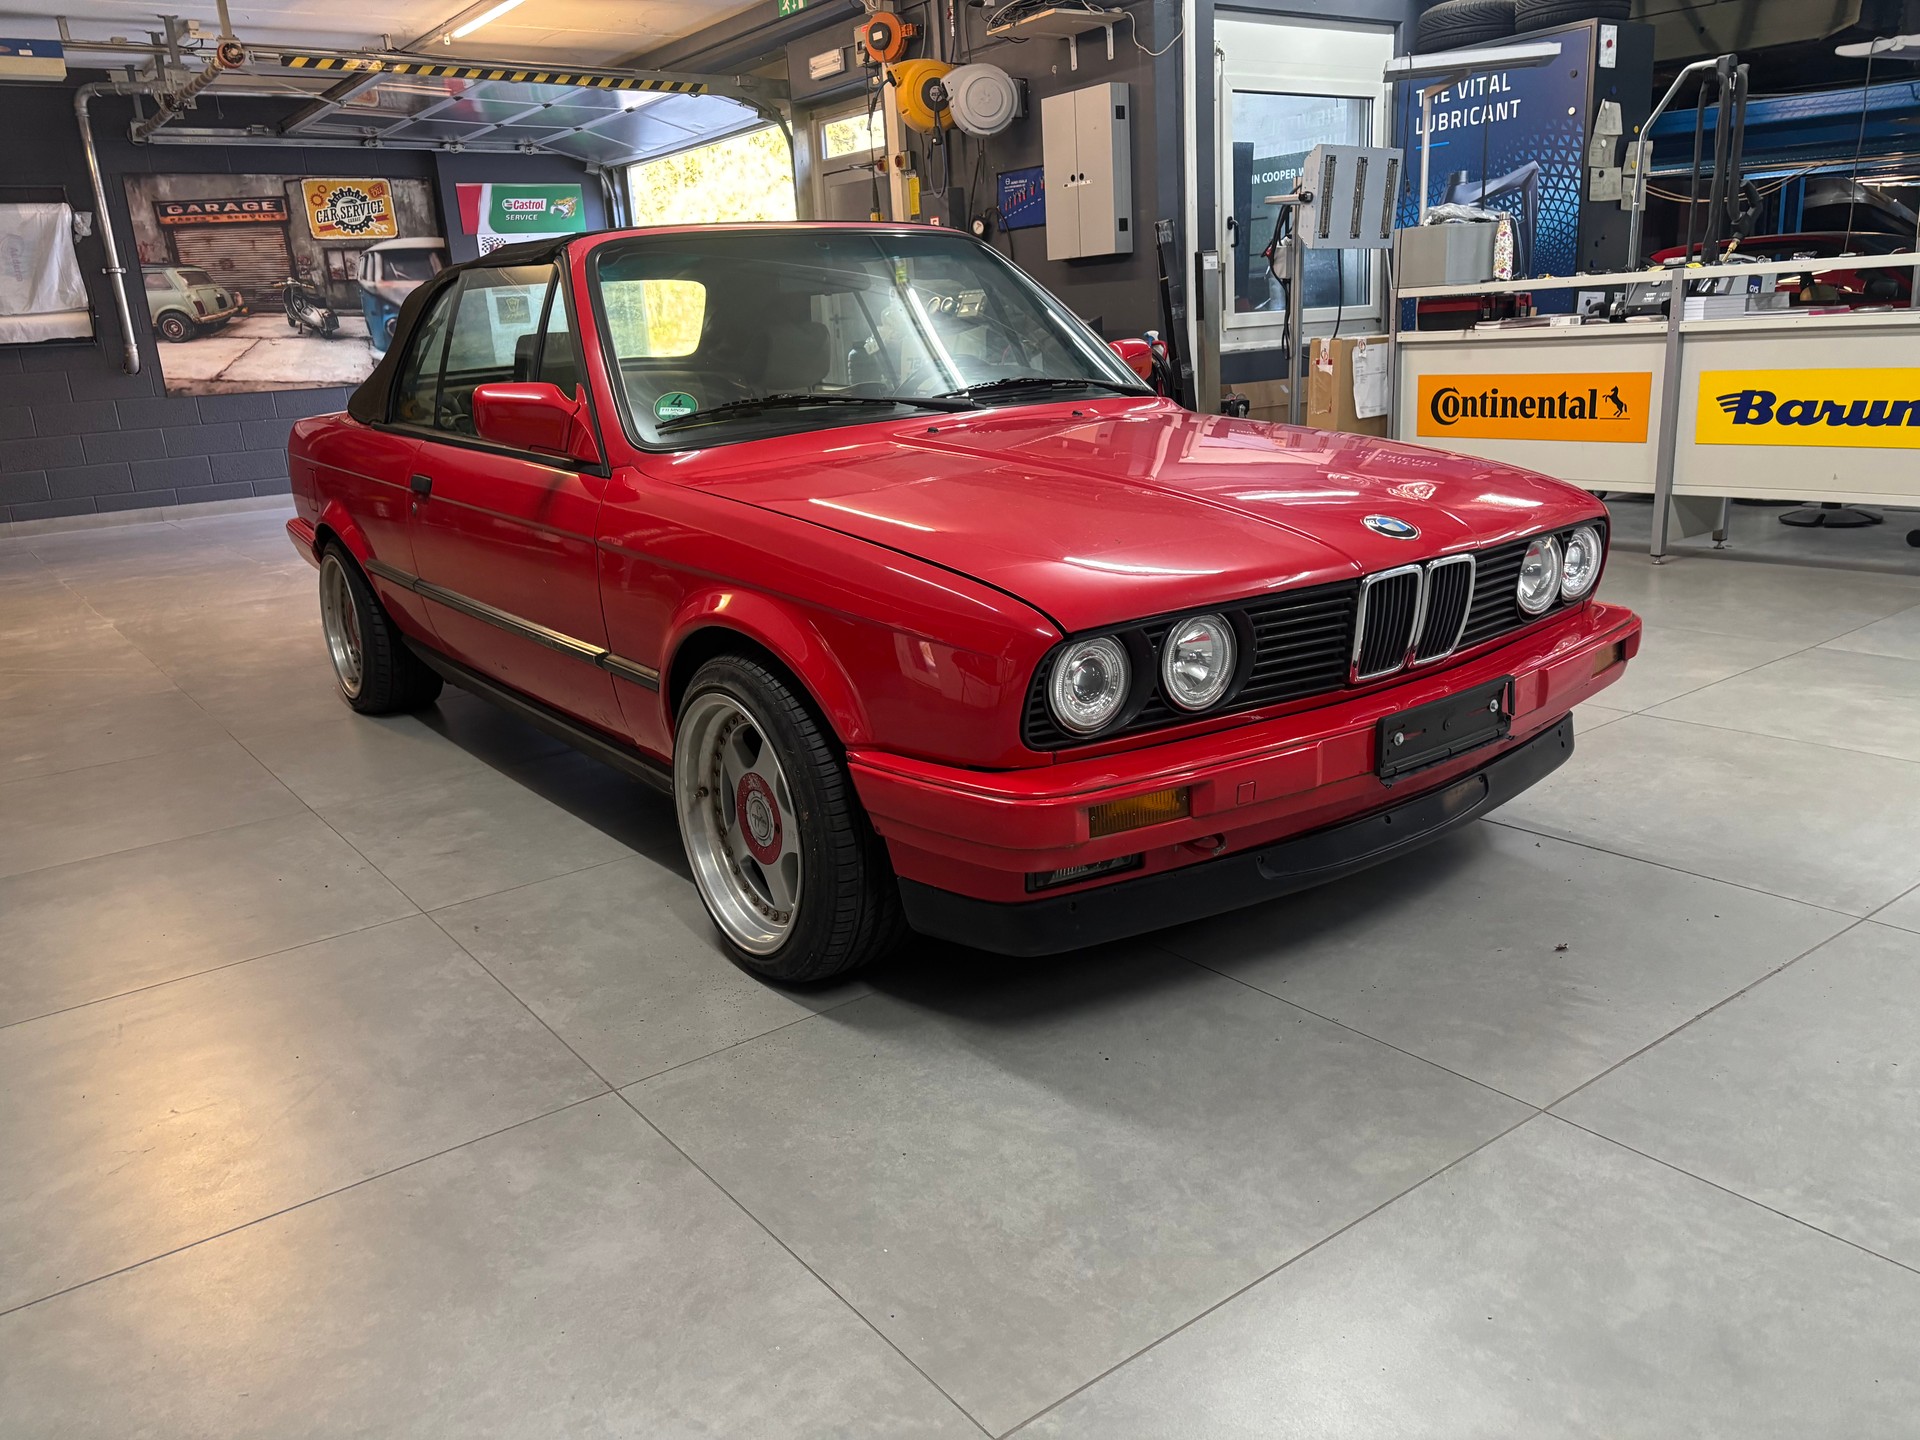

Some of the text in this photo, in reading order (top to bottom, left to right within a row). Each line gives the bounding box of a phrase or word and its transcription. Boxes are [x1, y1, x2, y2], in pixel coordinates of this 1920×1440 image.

[1416, 72, 1511, 107] TE VITAL
[1261, 168, 1296, 183] COOPER
[166, 201, 278, 215] GARAGE
[513, 199, 544, 210] Castrol
[316, 200, 384, 224] CAR SERVICE
[505, 213, 538, 221] SERVICE
[671, 394, 682, 408] 4
[1430, 386, 1598, 426] Continental
